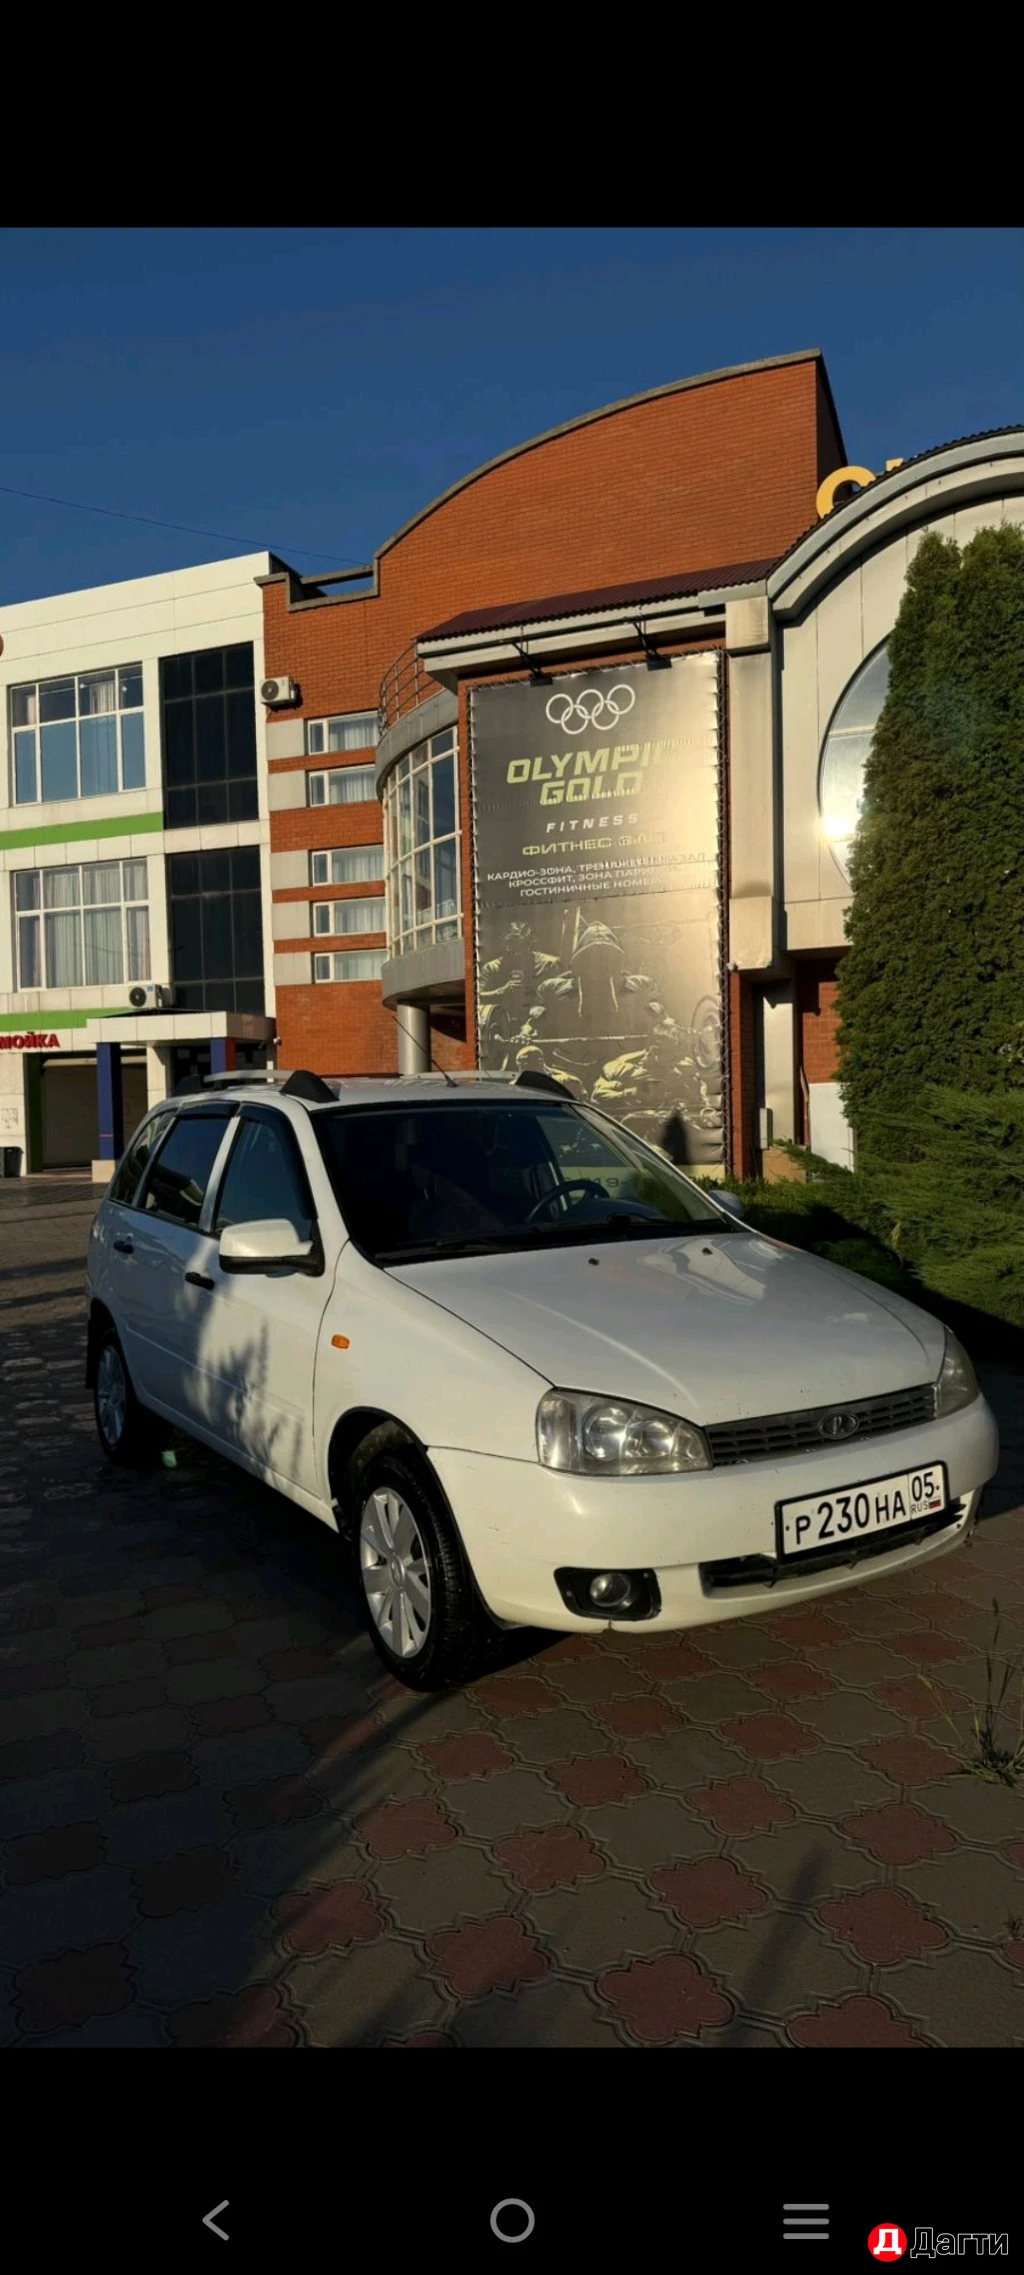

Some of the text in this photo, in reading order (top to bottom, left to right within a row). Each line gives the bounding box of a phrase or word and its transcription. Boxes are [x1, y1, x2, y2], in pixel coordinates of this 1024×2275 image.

[539, 771, 643, 806] GOLD
[546, 812, 639, 833] FITNESS
[522, 837, 612, 856] ФИТНЕС
[487, 865, 576, 881] КАРДИО-ЗОНА,
[509, 875, 576, 888] КРОССФИТ,
[578, 870, 613, 882] ЗОНА
[520, 881, 610, 897] ГОСТИНИЧНЫЕ
[911, 1471, 935, 1502] 05
[911, 1502, 929, 1514] RUS
